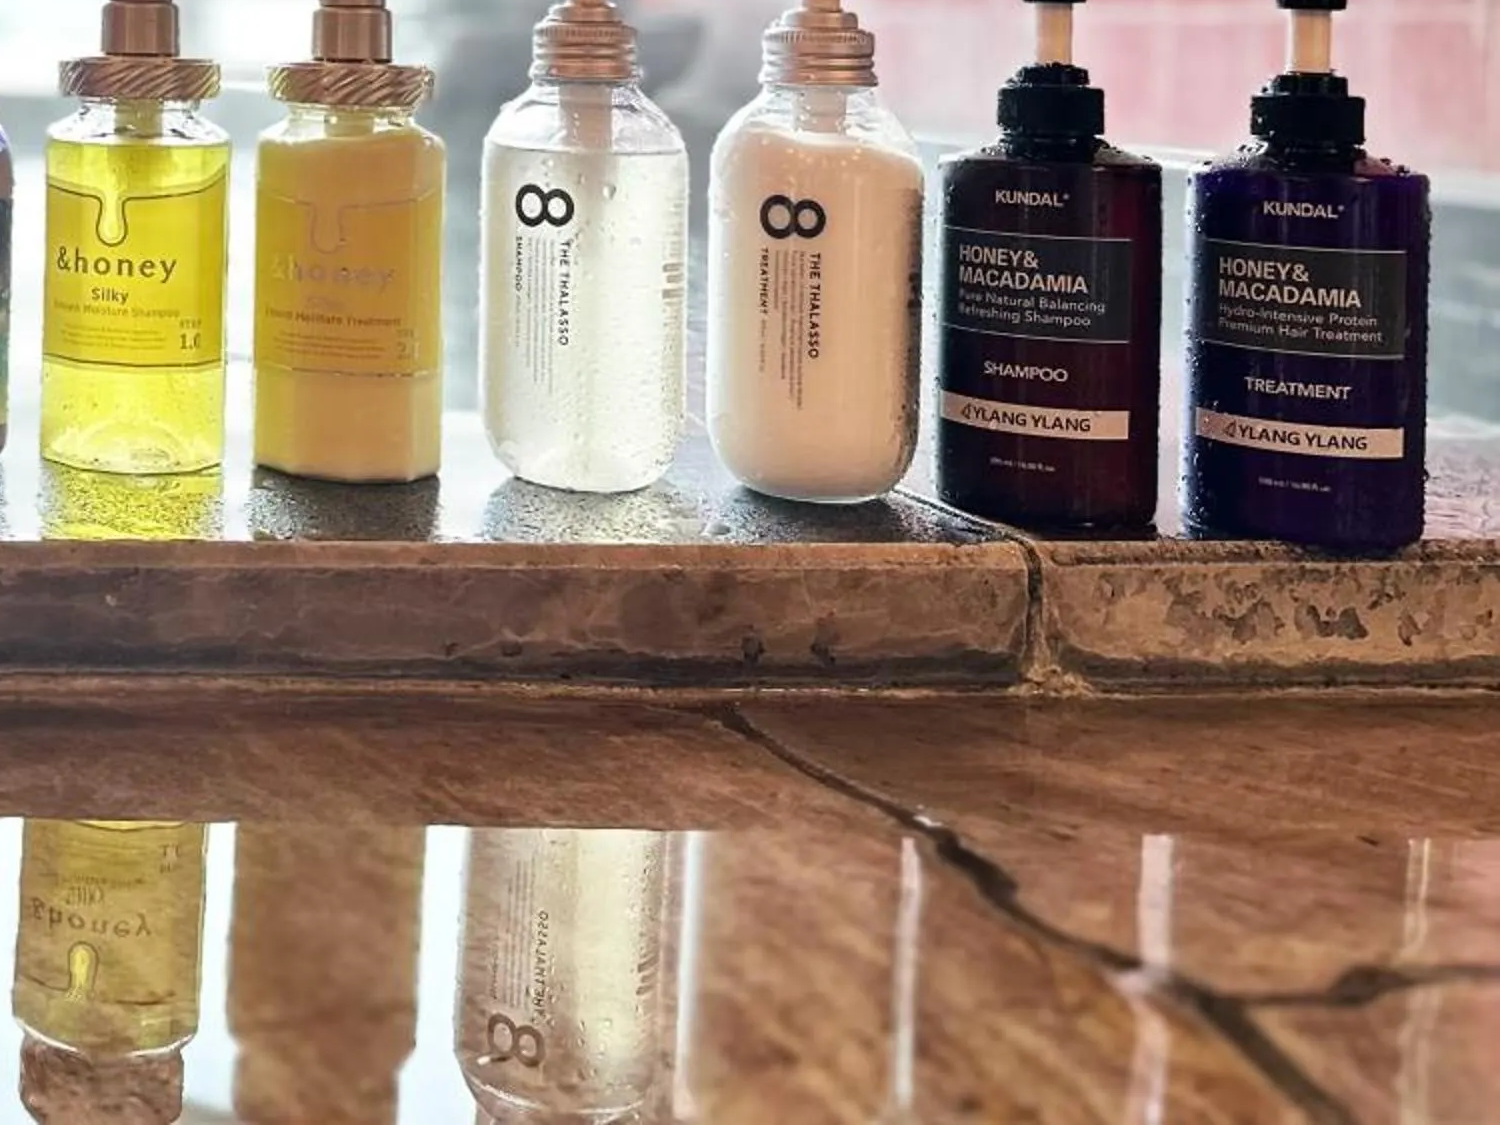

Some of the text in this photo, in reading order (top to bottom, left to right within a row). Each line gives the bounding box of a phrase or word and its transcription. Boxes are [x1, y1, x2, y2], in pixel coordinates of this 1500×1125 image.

[57, 246, 177, 283] &honey
[515, 236, 523, 292] SHAMPOO
[959, 244, 1039, 269] HONEY&
[1219, 256, 1309, 282] HONEY&
[557, 239, 571, 346] THE THALASSO
[759, 247, 769, 315] TREATMENT
[959, 265, 1088, 294] MACADAMIA
[91, 287, 129, 304] Silky
[807, 252, 822, 360] THE THALASSO
[986, 293, 1035, 307] Natural
[1040, 296, 1105, 315] Balancing
[1219, 278, 1362, 308] MACADAMIA
[1025, 310, 1092, 328] Shampoo
[1219, 303, 1378, 327] Hydro-Intensive Protein
[1218, 317, 1382, 342] Premium Hair Treatment
[983, 360, 1069, 382] SHAMPOO
[1244, 376, 1353, 400] TREATMENT
[973, 406, 1091, 432] YLANG YLANG
[1238, 424, 1368, 450] YLANG YLANG
